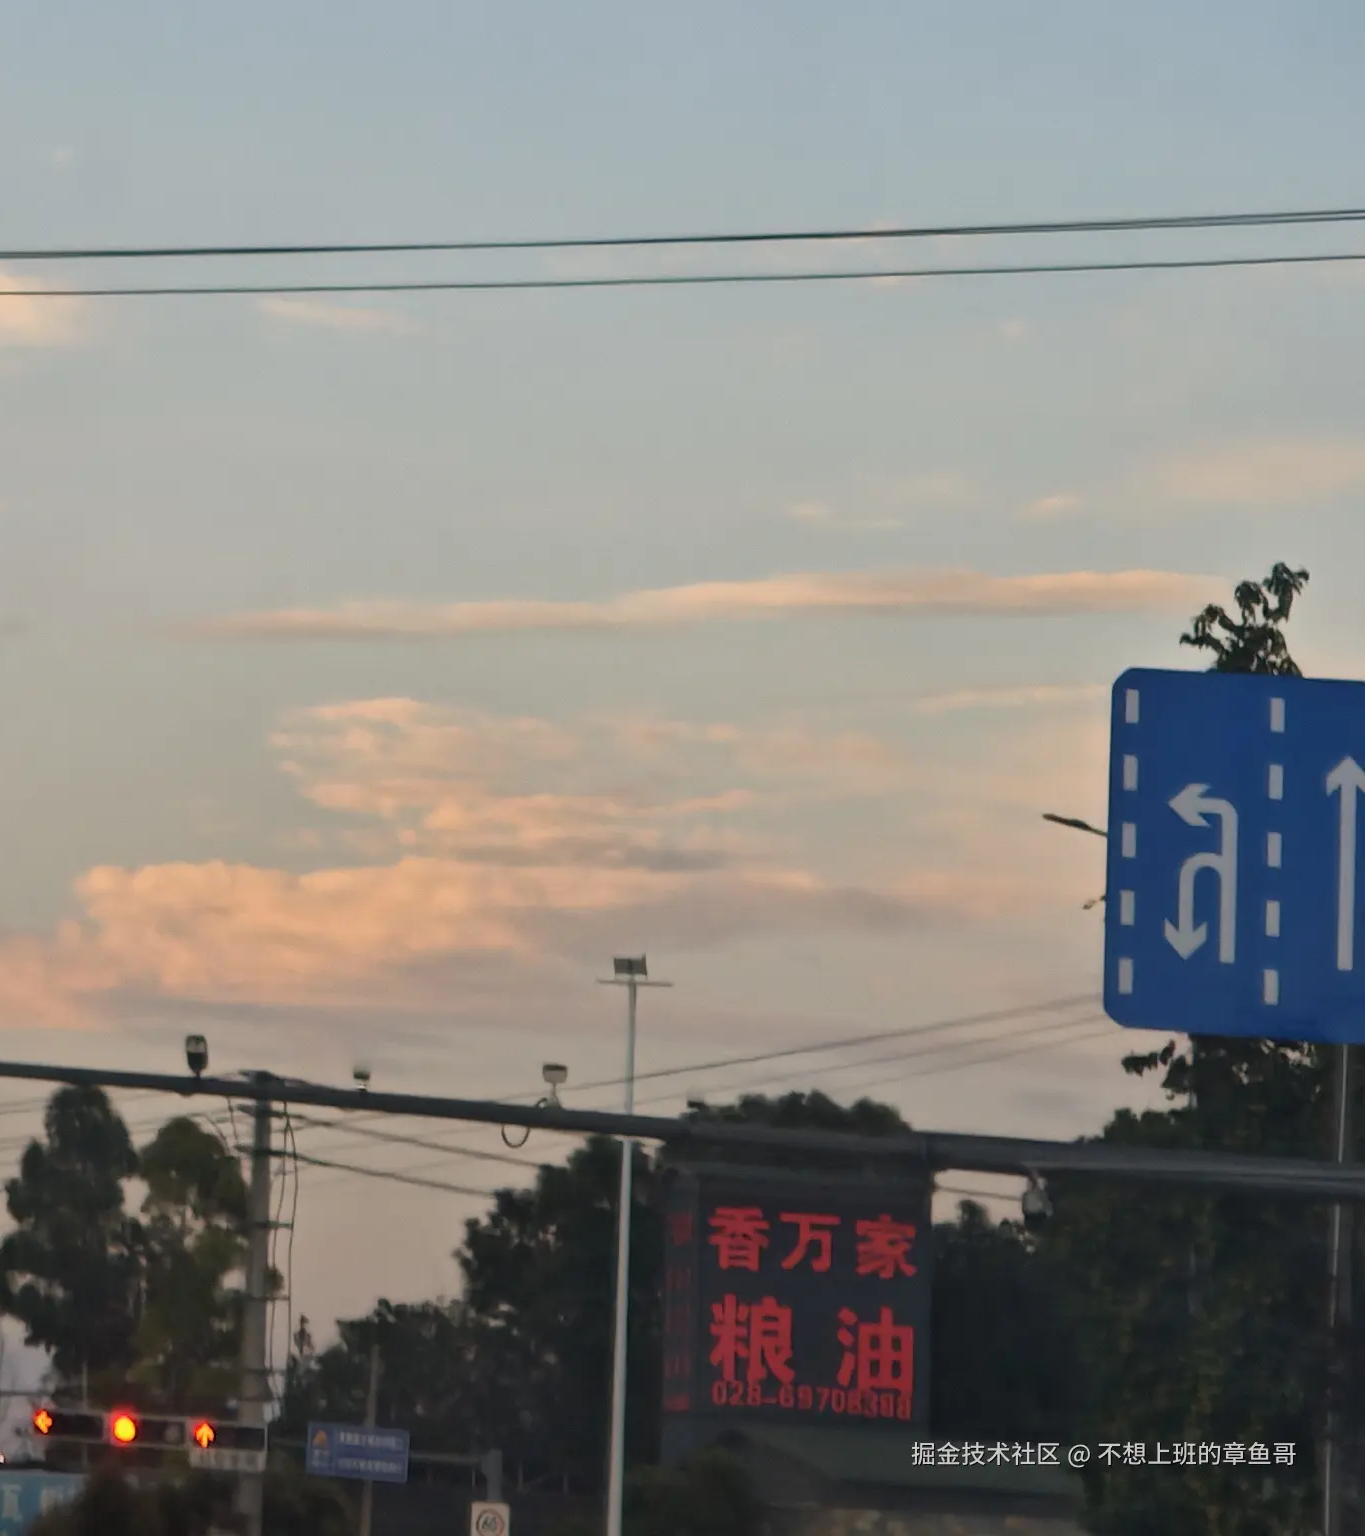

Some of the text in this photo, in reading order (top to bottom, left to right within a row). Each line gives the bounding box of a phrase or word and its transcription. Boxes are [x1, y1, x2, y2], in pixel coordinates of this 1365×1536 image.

[709, 1207, 916, 1279] 香万家
[709, 1293, 915, 1392] 粮油
